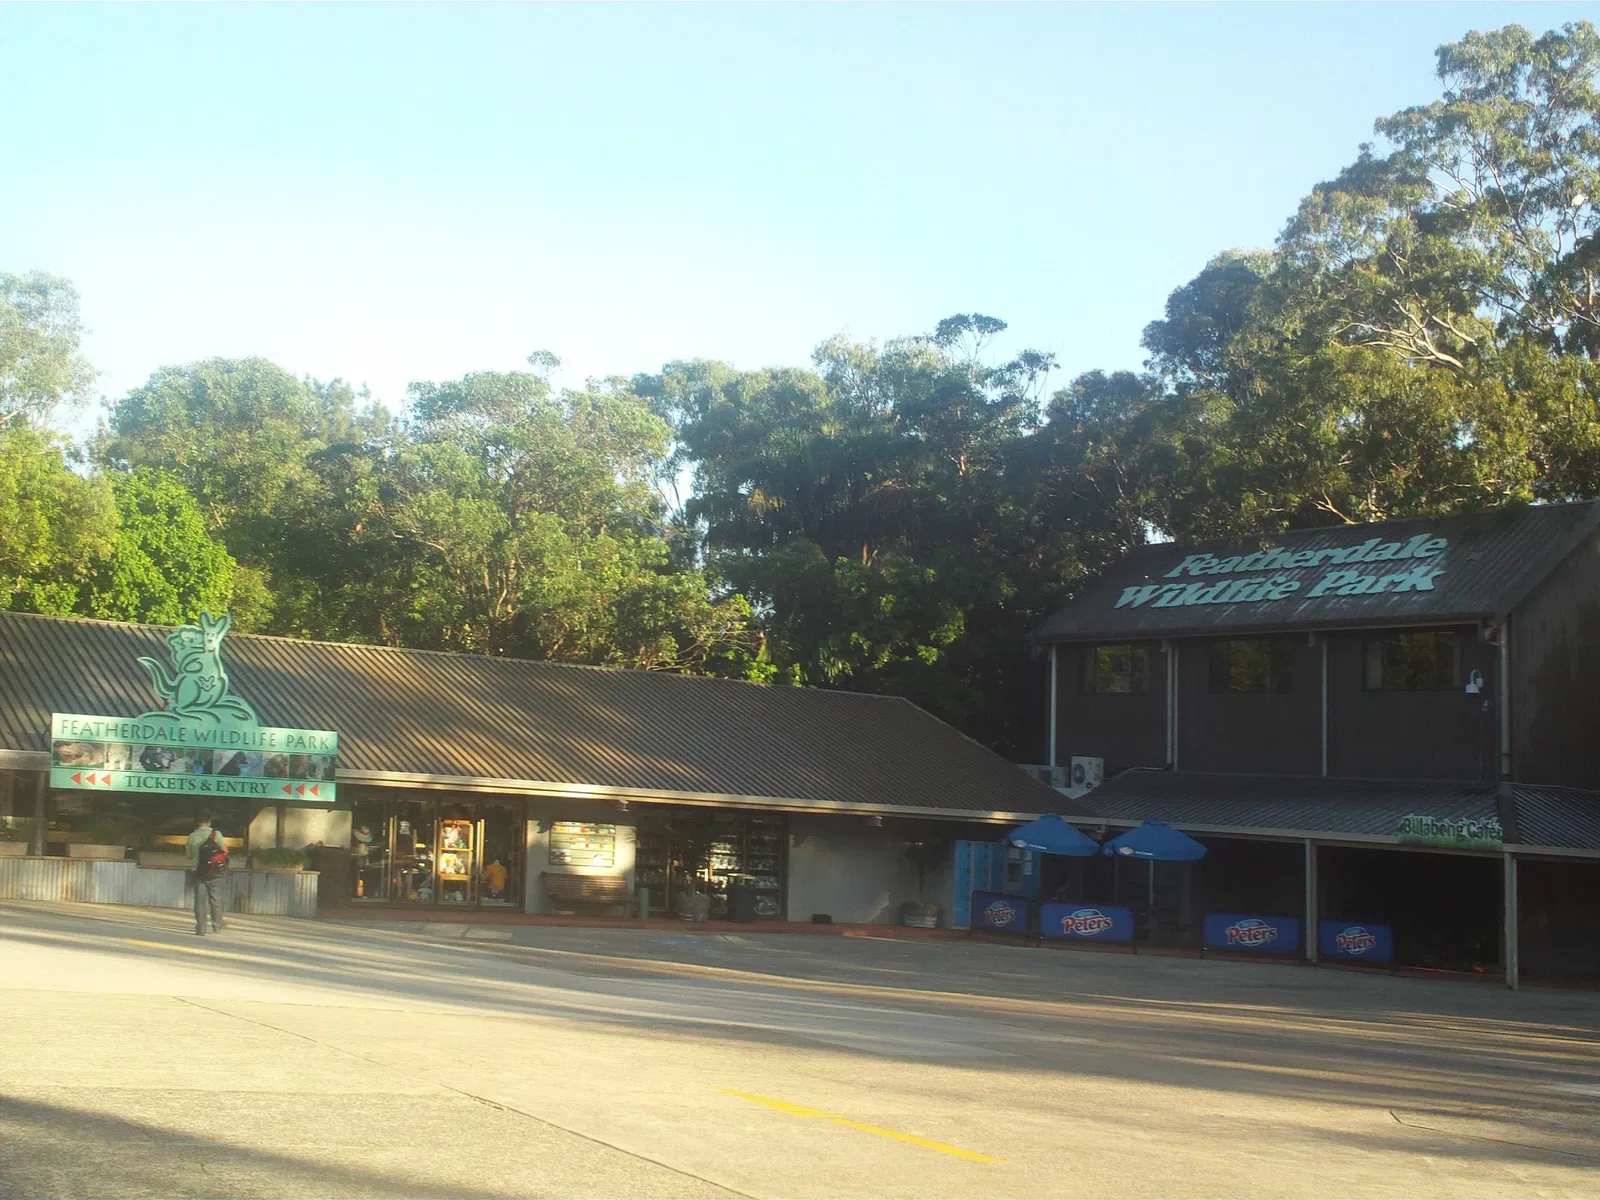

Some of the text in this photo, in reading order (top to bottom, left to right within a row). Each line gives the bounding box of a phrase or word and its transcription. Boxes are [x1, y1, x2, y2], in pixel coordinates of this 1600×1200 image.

[1163, 532, 1449, 579] Featherdale
[1114, 565, 1447, 610] Wildlife Park
[60, 718, 331, 750] FEATHERDALE WILDLIFE PARK
[125, 774, 271, 795] TICKETS & ENTRY
[984, 906, 1016, 925] Peters
[1061, 915, 1112, 934] Peters
[1225, 926, 1278, 945] Peters
[1335, 933, 1376, 952] Peters
